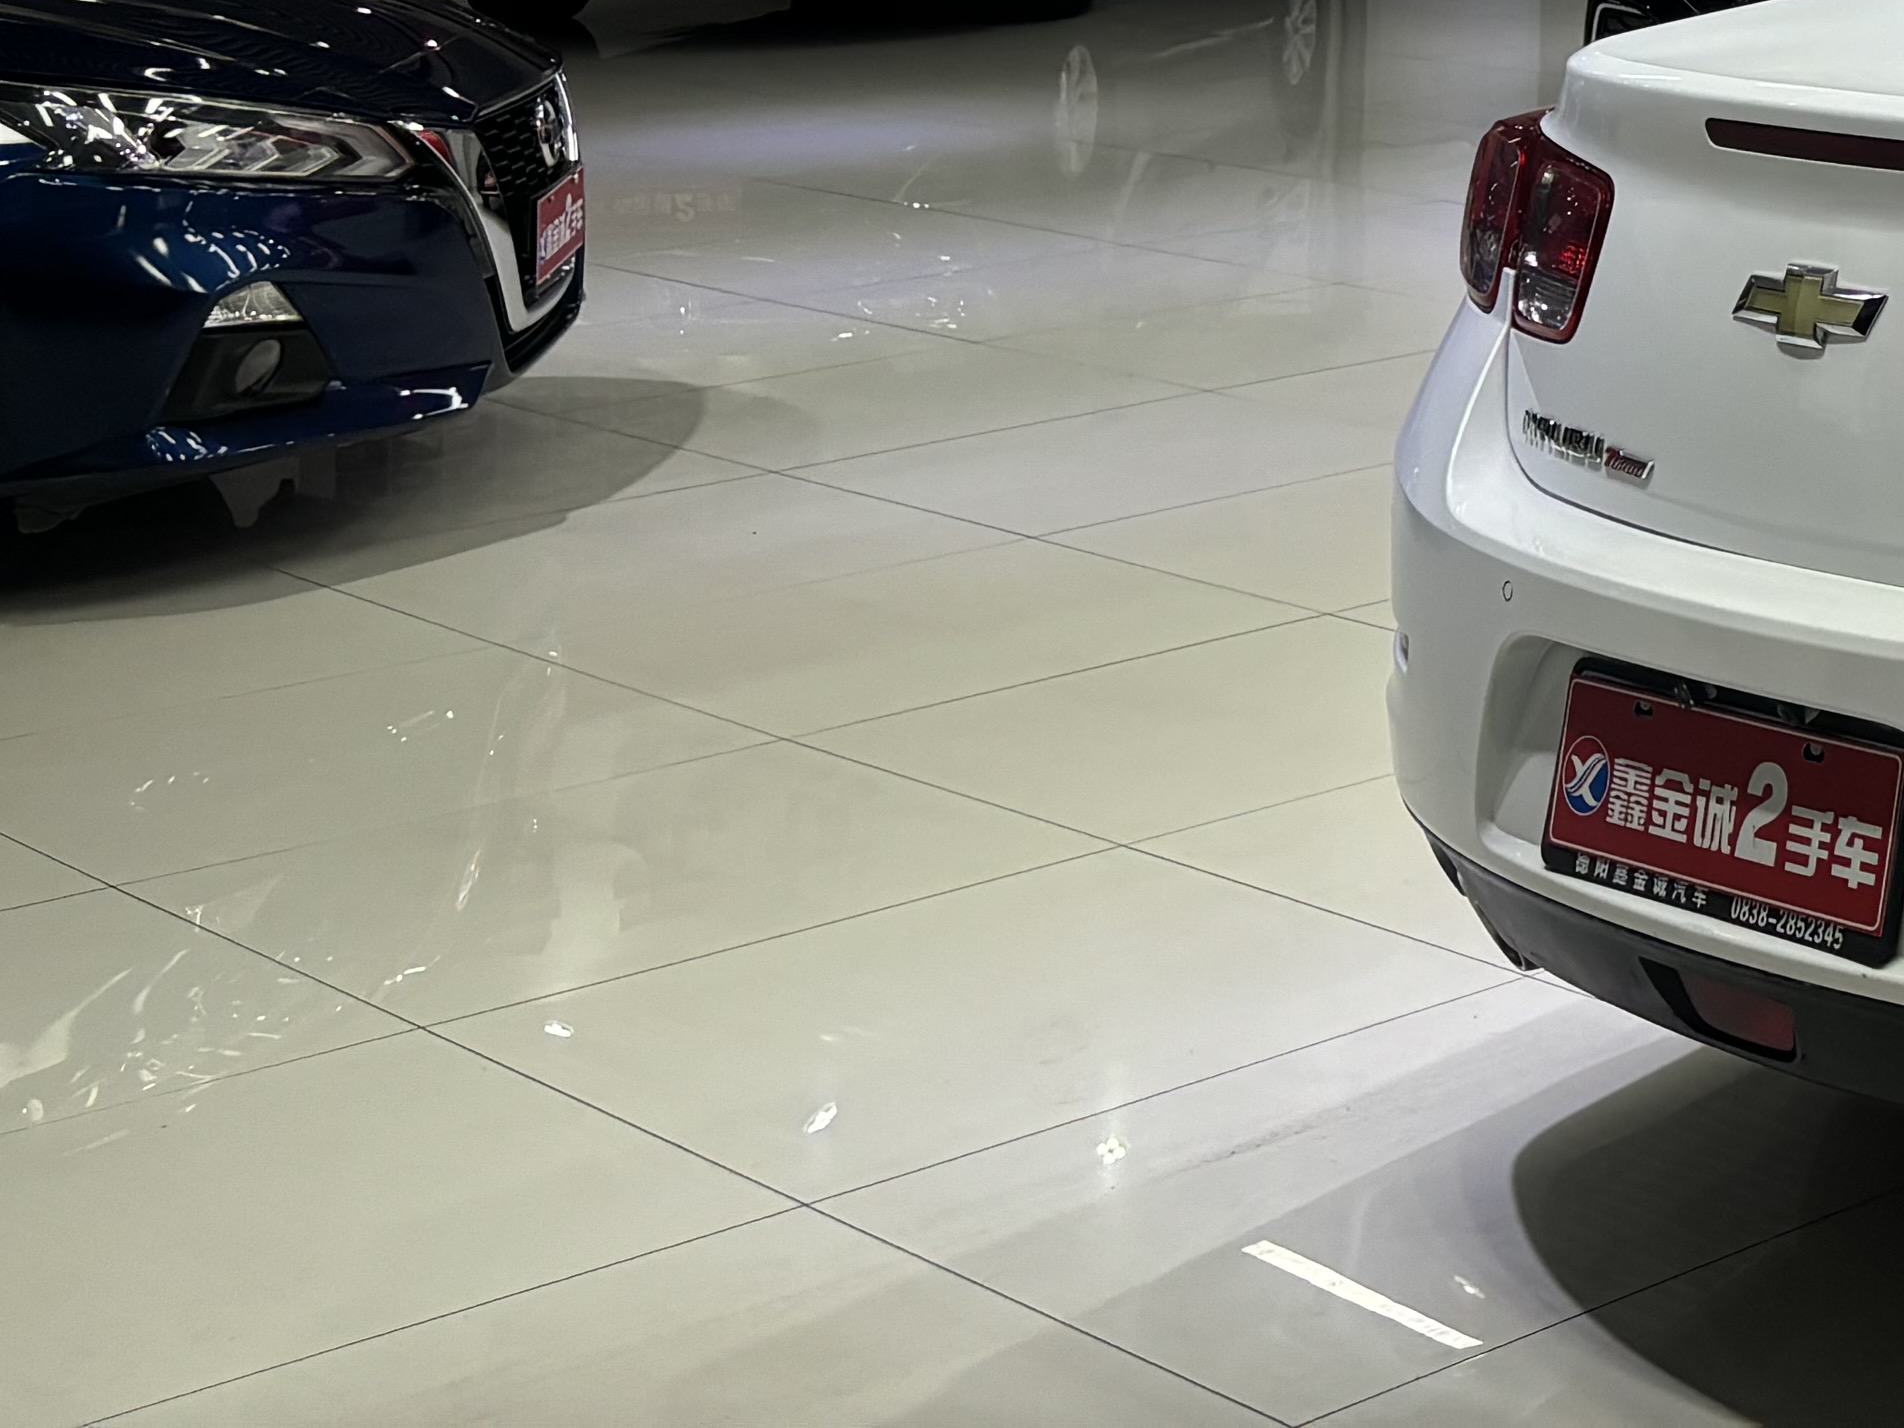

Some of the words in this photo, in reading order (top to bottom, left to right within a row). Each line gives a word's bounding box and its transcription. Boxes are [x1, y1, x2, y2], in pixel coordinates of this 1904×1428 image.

[1606, 757, 1882, 889] 鑫金诚2手车
[1730, 896, 1845, 950] 0838-2852345
